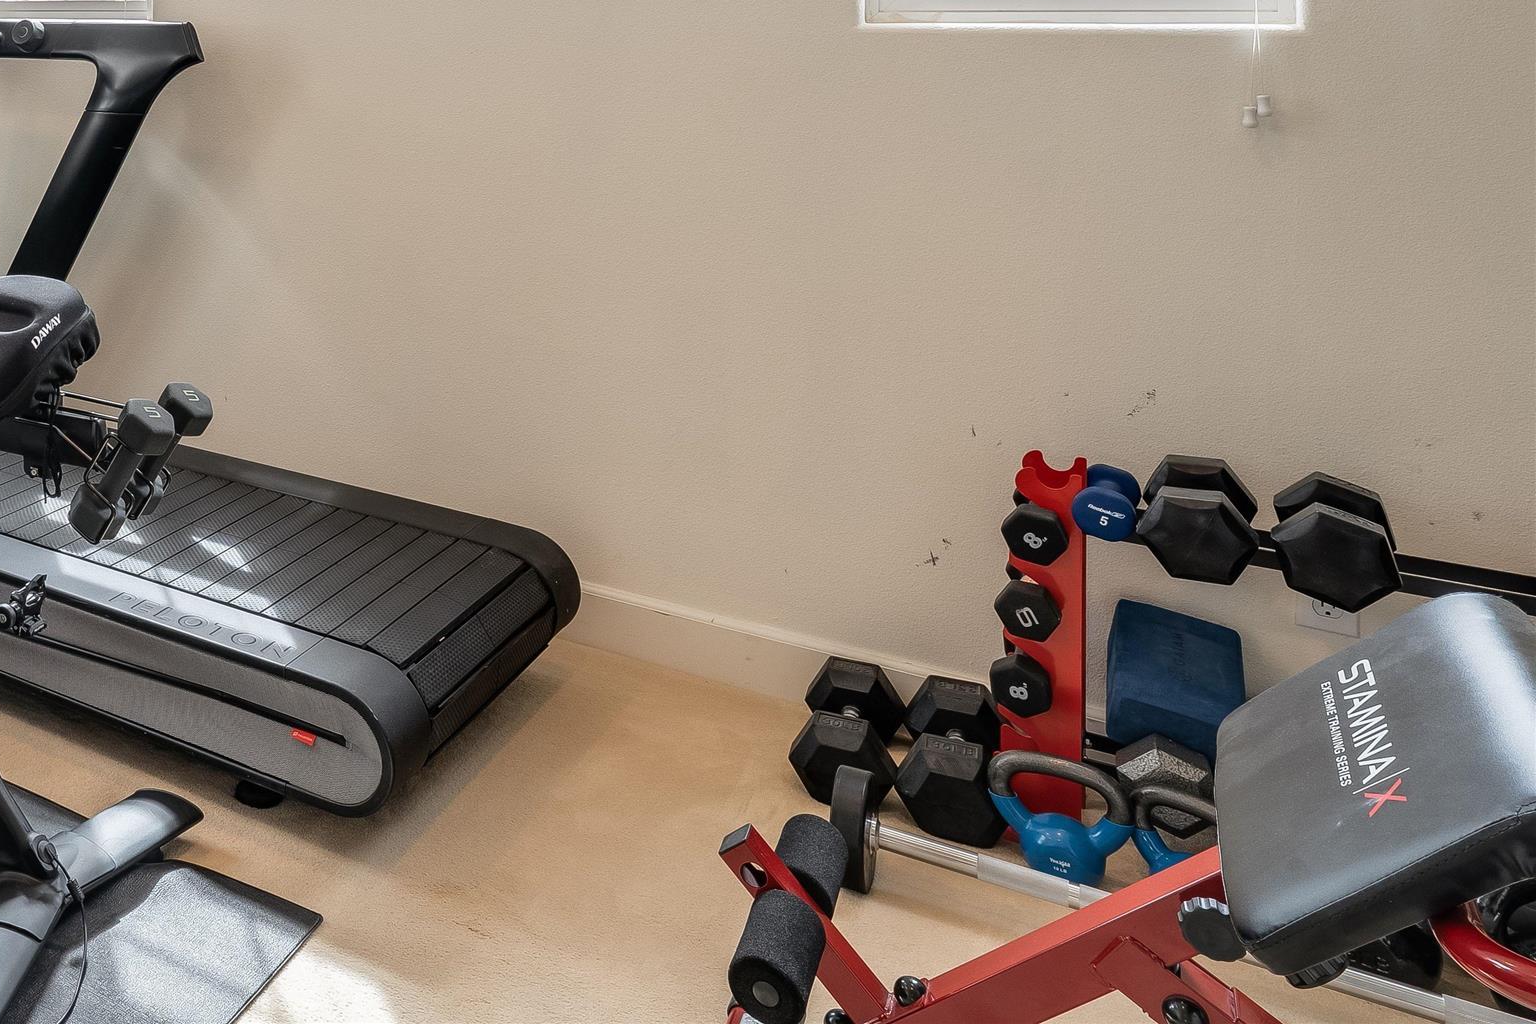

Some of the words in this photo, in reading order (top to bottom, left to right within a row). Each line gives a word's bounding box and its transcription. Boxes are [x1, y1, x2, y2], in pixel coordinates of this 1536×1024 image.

[31, 313, 61, 350] DAWAY
[144, 406, 162, 418] 5
[183, 390, 200, 402] 5
[1099, 516, 1109, 527] 5
[1023, 532, 1043, 549] 8
[108, 591, 298, 659] PELOTON
[1009, 685, 1029, 701] 8
[1320, 681, 1337, 716] EXTREME
[1327, 714, 1346, 755] TRAINING
[1337, 658, 1397, 785] STAMINA
[1335, 755, 1353, 787] SERIES
[1364, 778, 1408, 818] X
